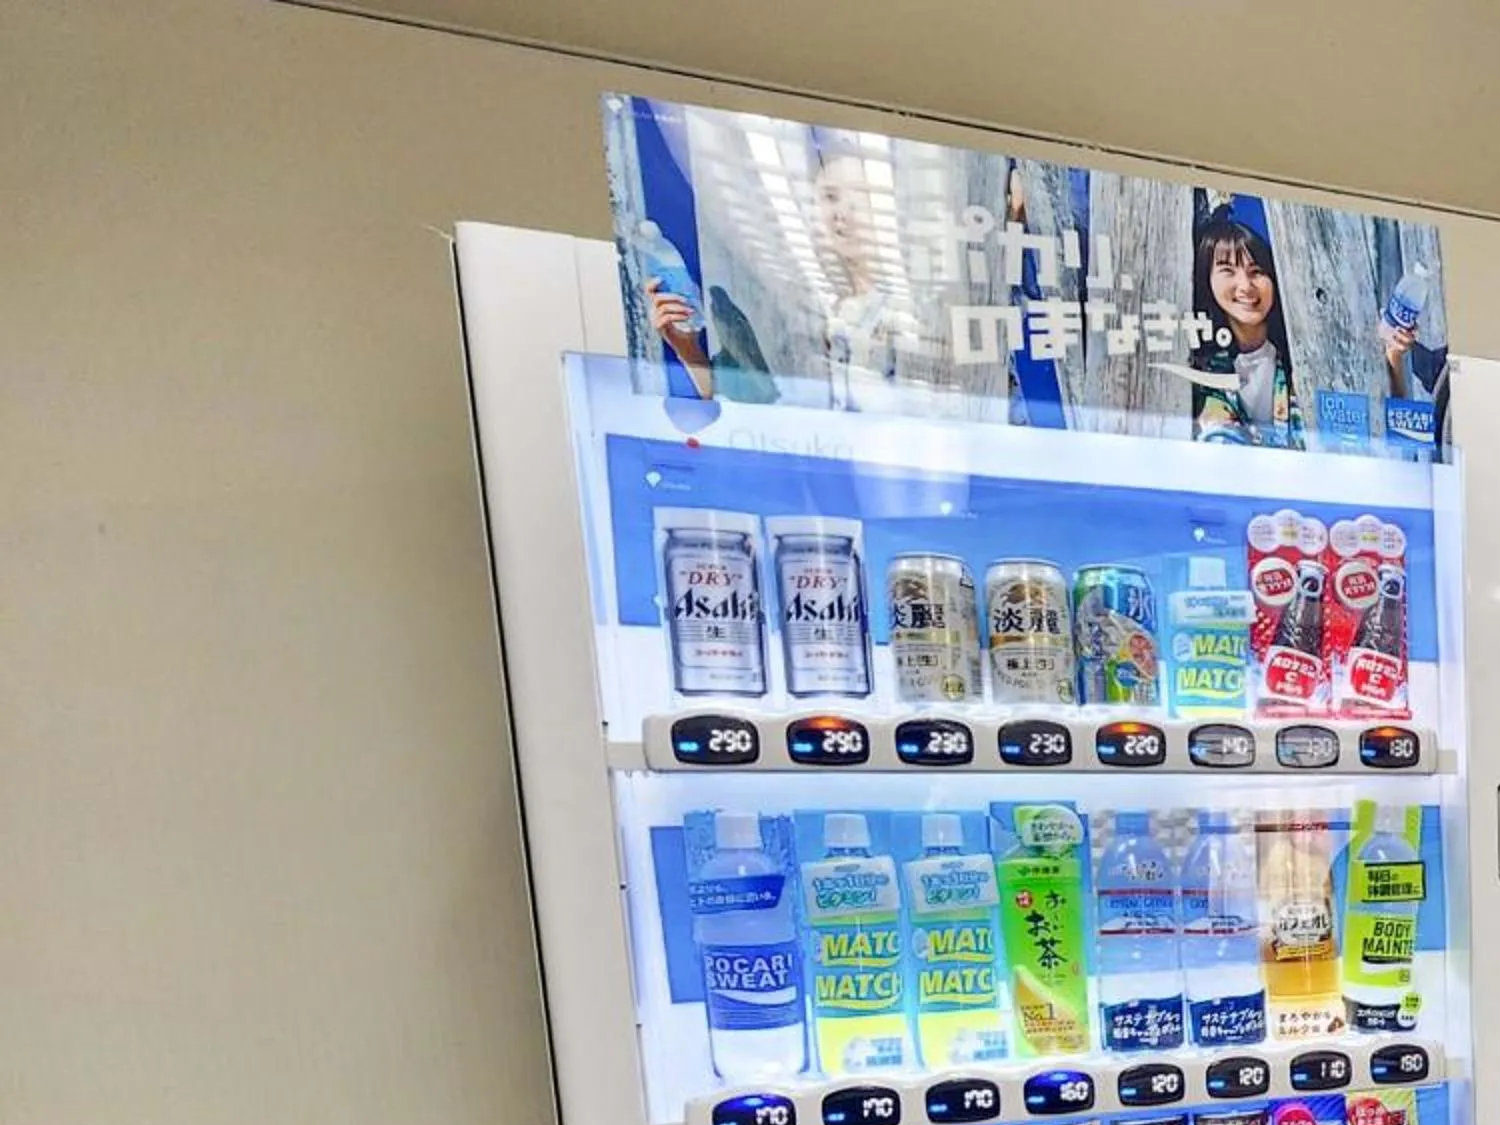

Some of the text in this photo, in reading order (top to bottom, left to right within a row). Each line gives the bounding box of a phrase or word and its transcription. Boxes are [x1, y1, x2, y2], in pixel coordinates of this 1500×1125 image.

[951, 297, 1232, 364] のまなきゃ。
[674, 588, 757, 621] Asahi
[786, 591, 860, 622] Asahi
[1177, 667, 1245, 689] MATC
[708, 729, 753, 753] 290
[822, 729, 863, 753] 290
[927, 730, 968, 754] 230
[1029, 734, 1065, 756] 230
[1124, 734, 1159, 757] 220
[1373, 920, 1411, 938] BODY
[824, 930, 900, 957] MATC
[704, 953, 792, 974] POCARI
[705, 969, 788, 989] SWEAT
[920, 968, 995, 994] MATC
[1151, 1072, 1179, 1093] 120
[1238, 1066, 1265, 1087] 120
